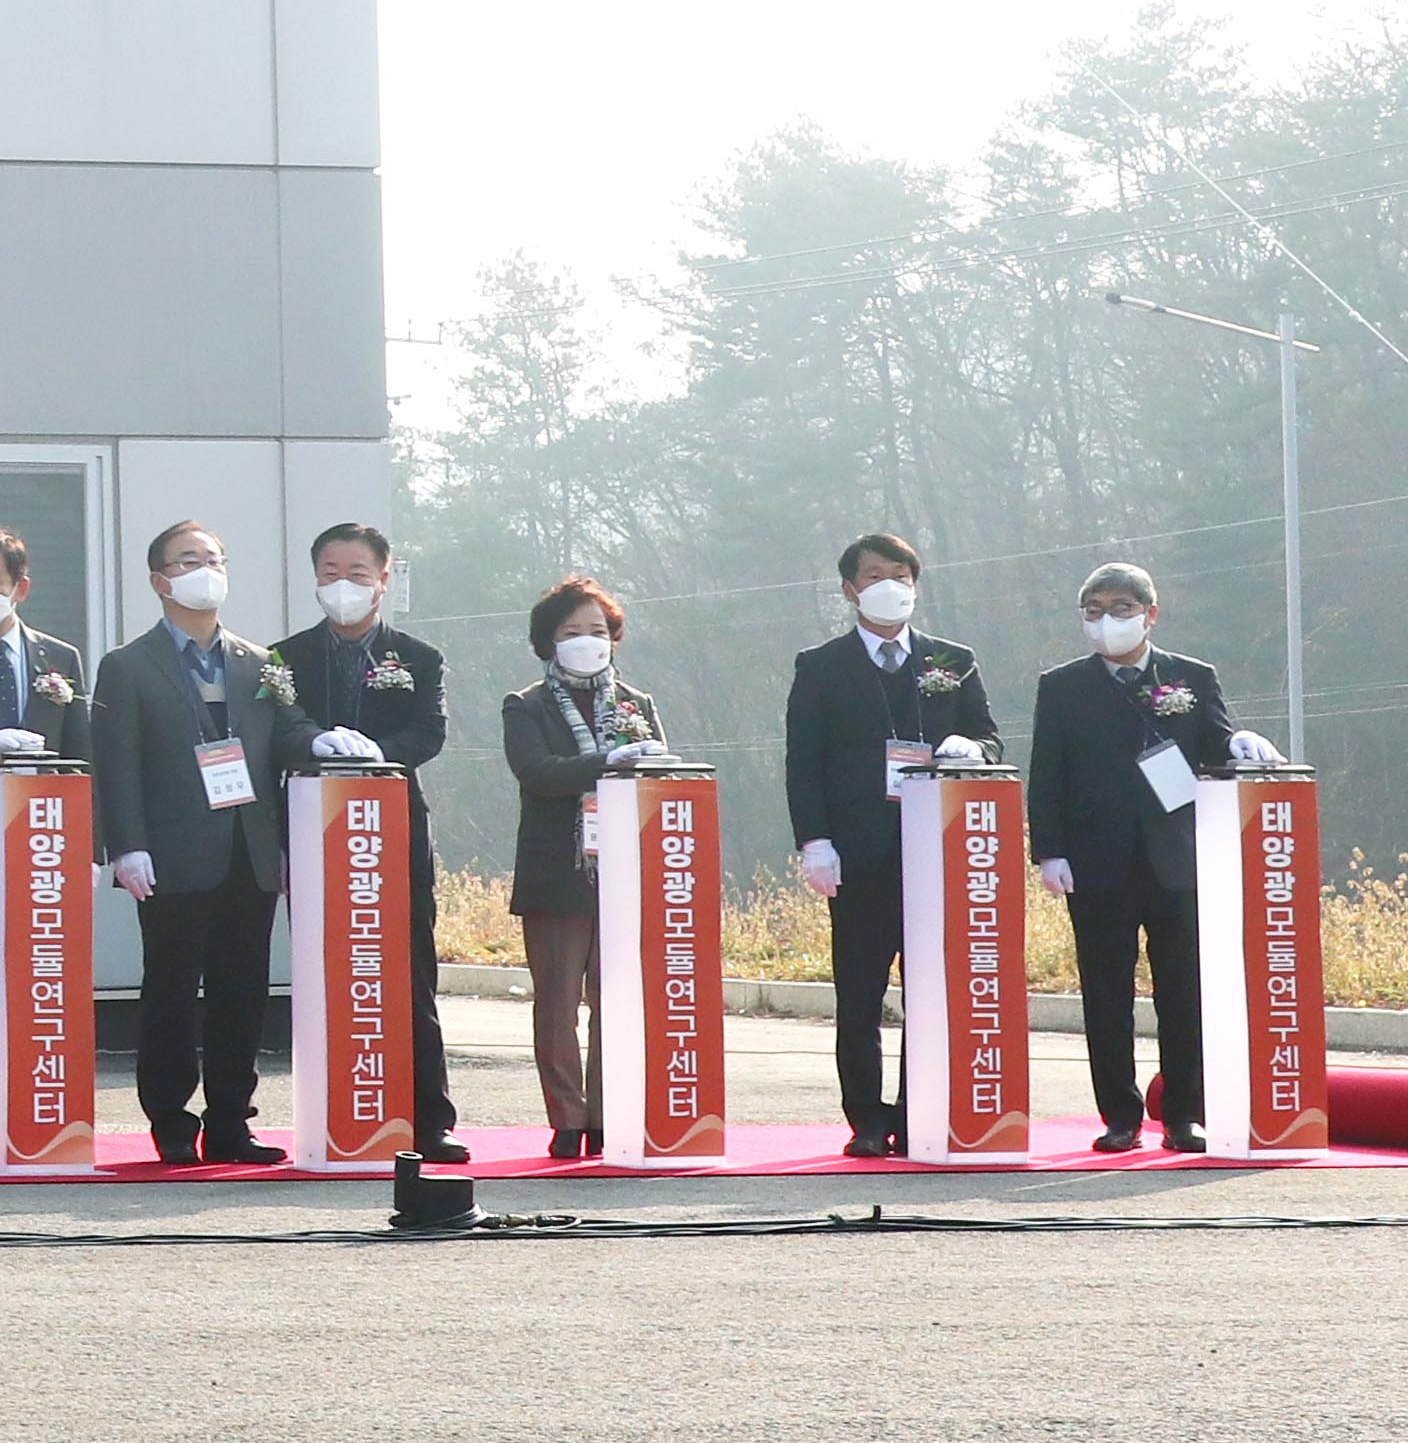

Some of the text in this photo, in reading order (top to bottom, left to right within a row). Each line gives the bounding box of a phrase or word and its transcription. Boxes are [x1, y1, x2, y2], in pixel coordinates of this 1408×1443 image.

[28, 797, 66, 1125] 태양광모듈연구센터
[347, 799, 385, 1122] 태양광모듈연구센터
[661, 800, 698, 1119] 태양광모듈연구센터
[965, 801, 1002, 1115] 태양광모듈연구센터
[1260, 801, 1301, 1112] 태양광모듈연구센터
